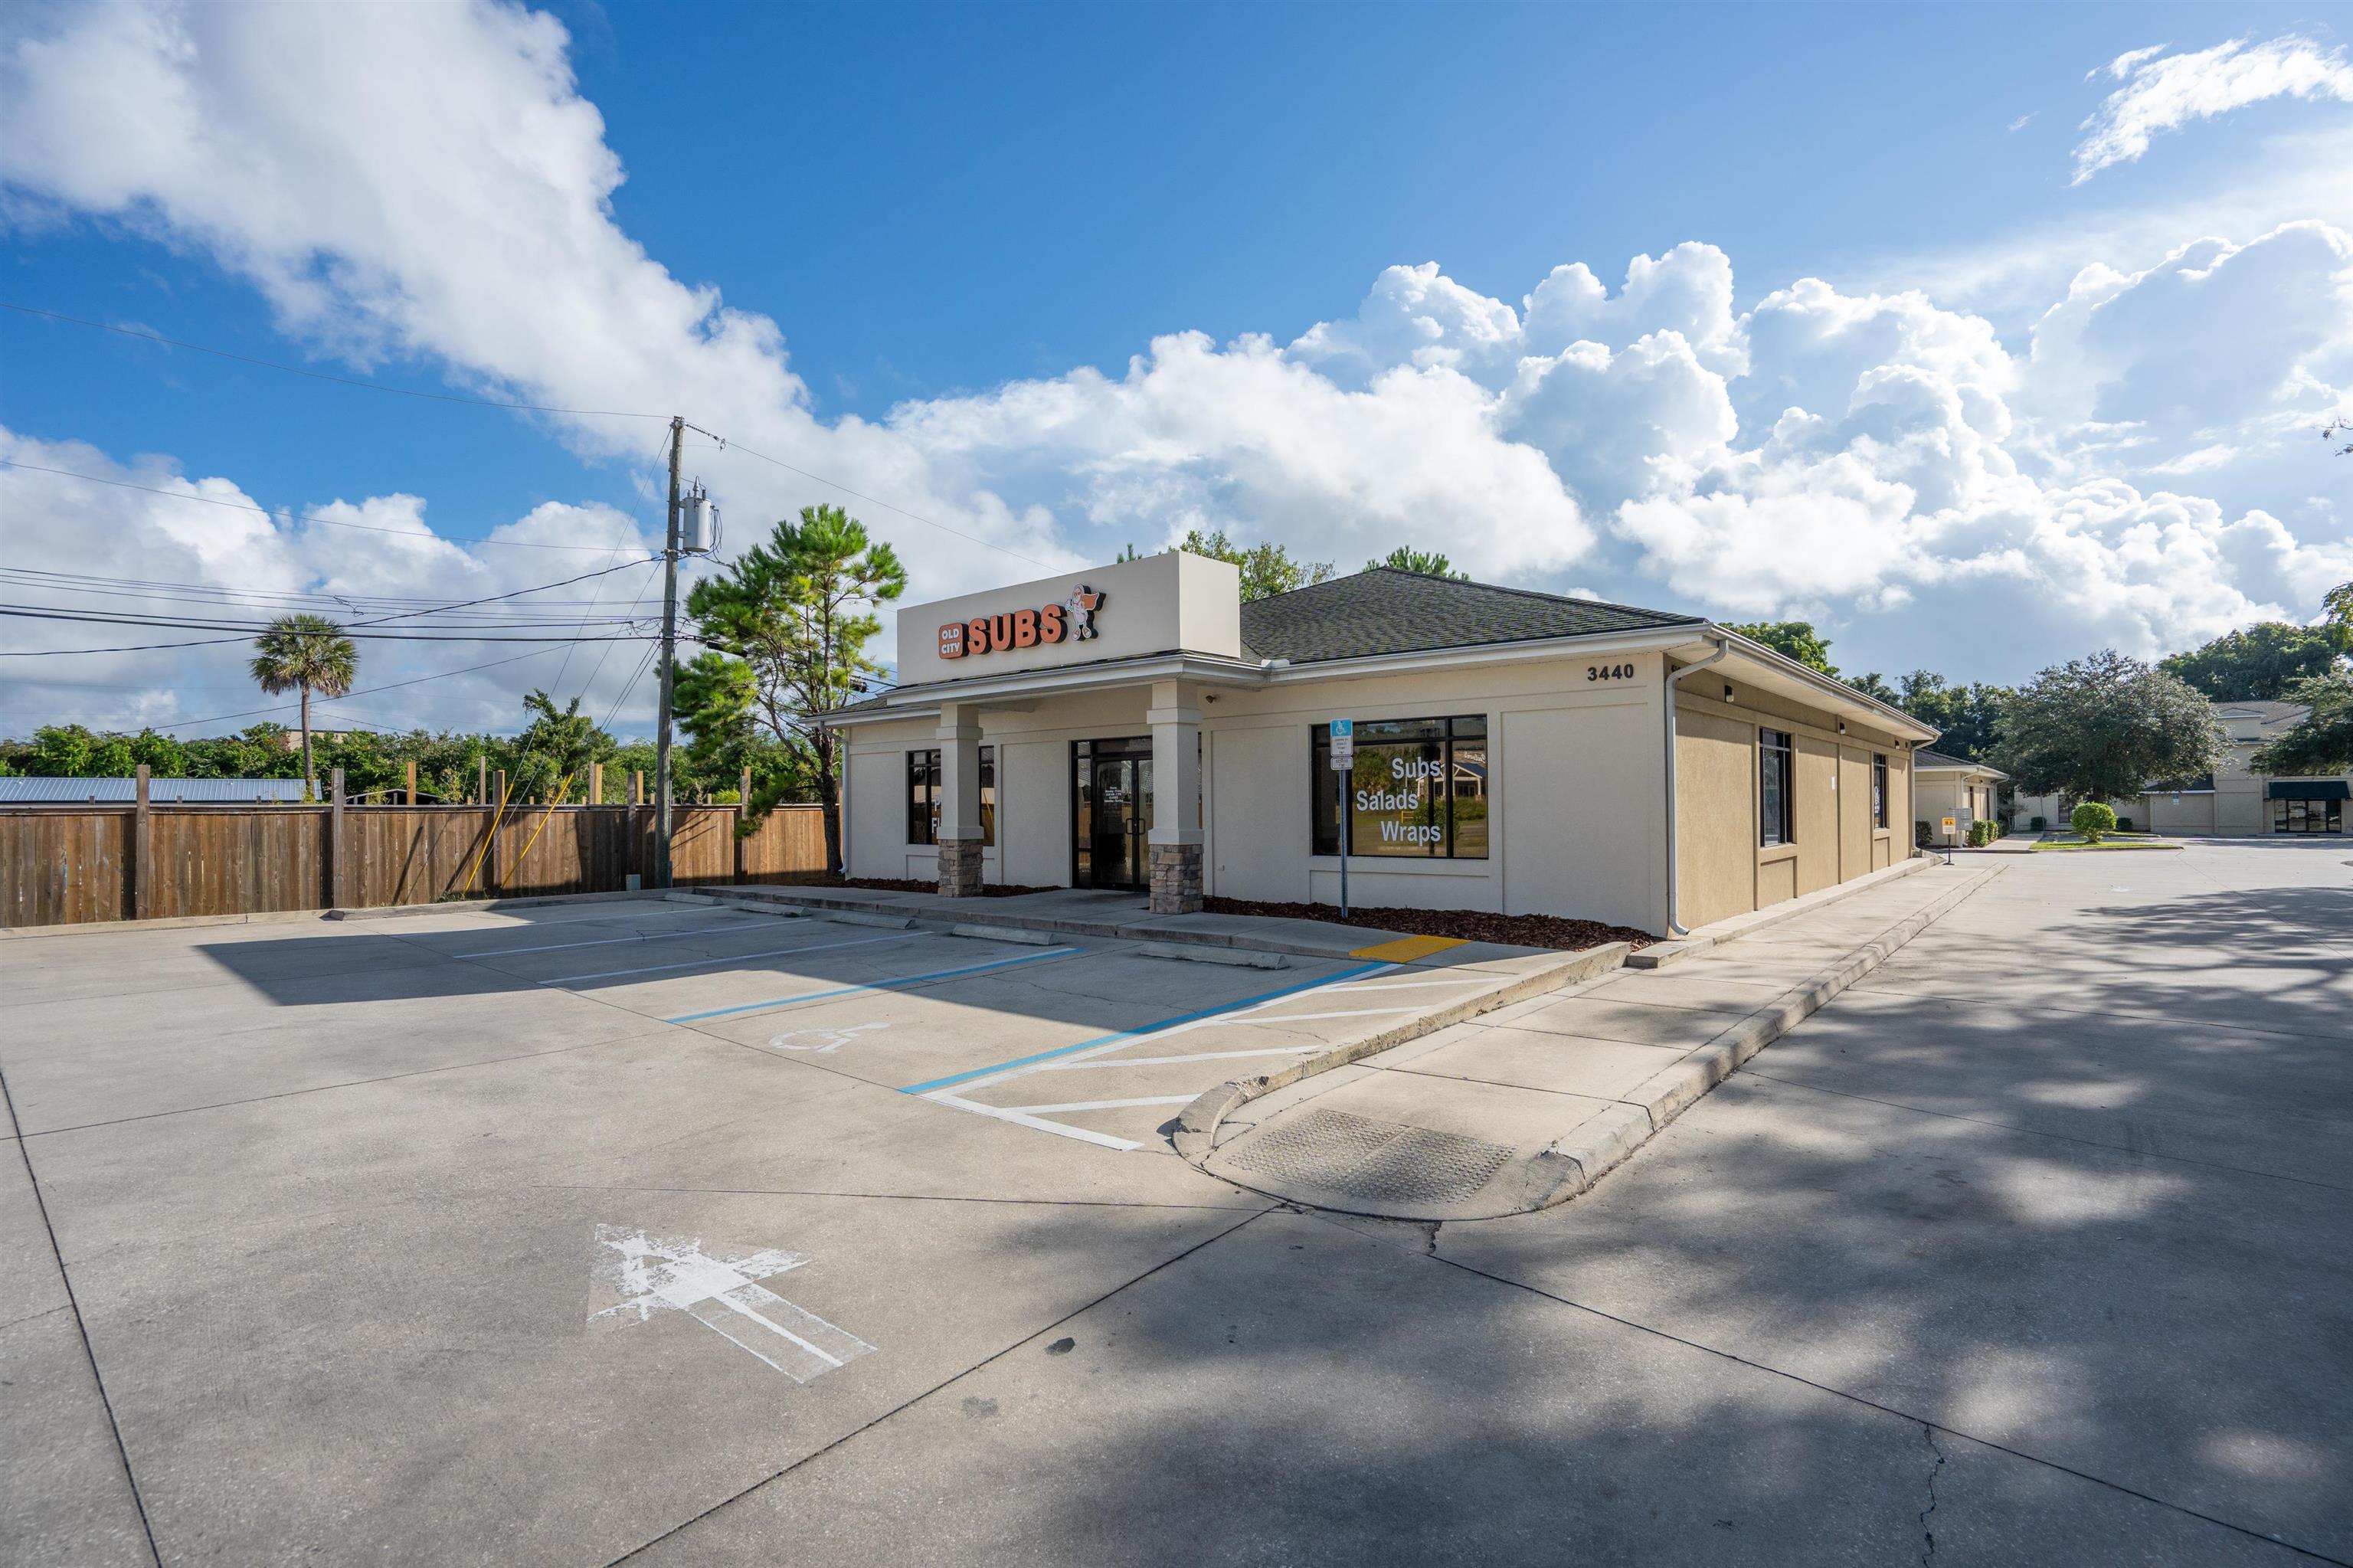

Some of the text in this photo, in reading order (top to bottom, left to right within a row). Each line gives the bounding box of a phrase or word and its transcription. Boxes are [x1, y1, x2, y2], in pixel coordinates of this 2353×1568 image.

[941, 628, 959, 640] OLD
[967, 604, 1065, 655] SUBS
[941, 642, 960, 654] CITY
[1587, 663, 1634, 682] 3440
[1392, 756, 1441, 779] Subs
[1356, 788, 1419, 811] Salads
[1380, 820, 1441, 847] Wraps
